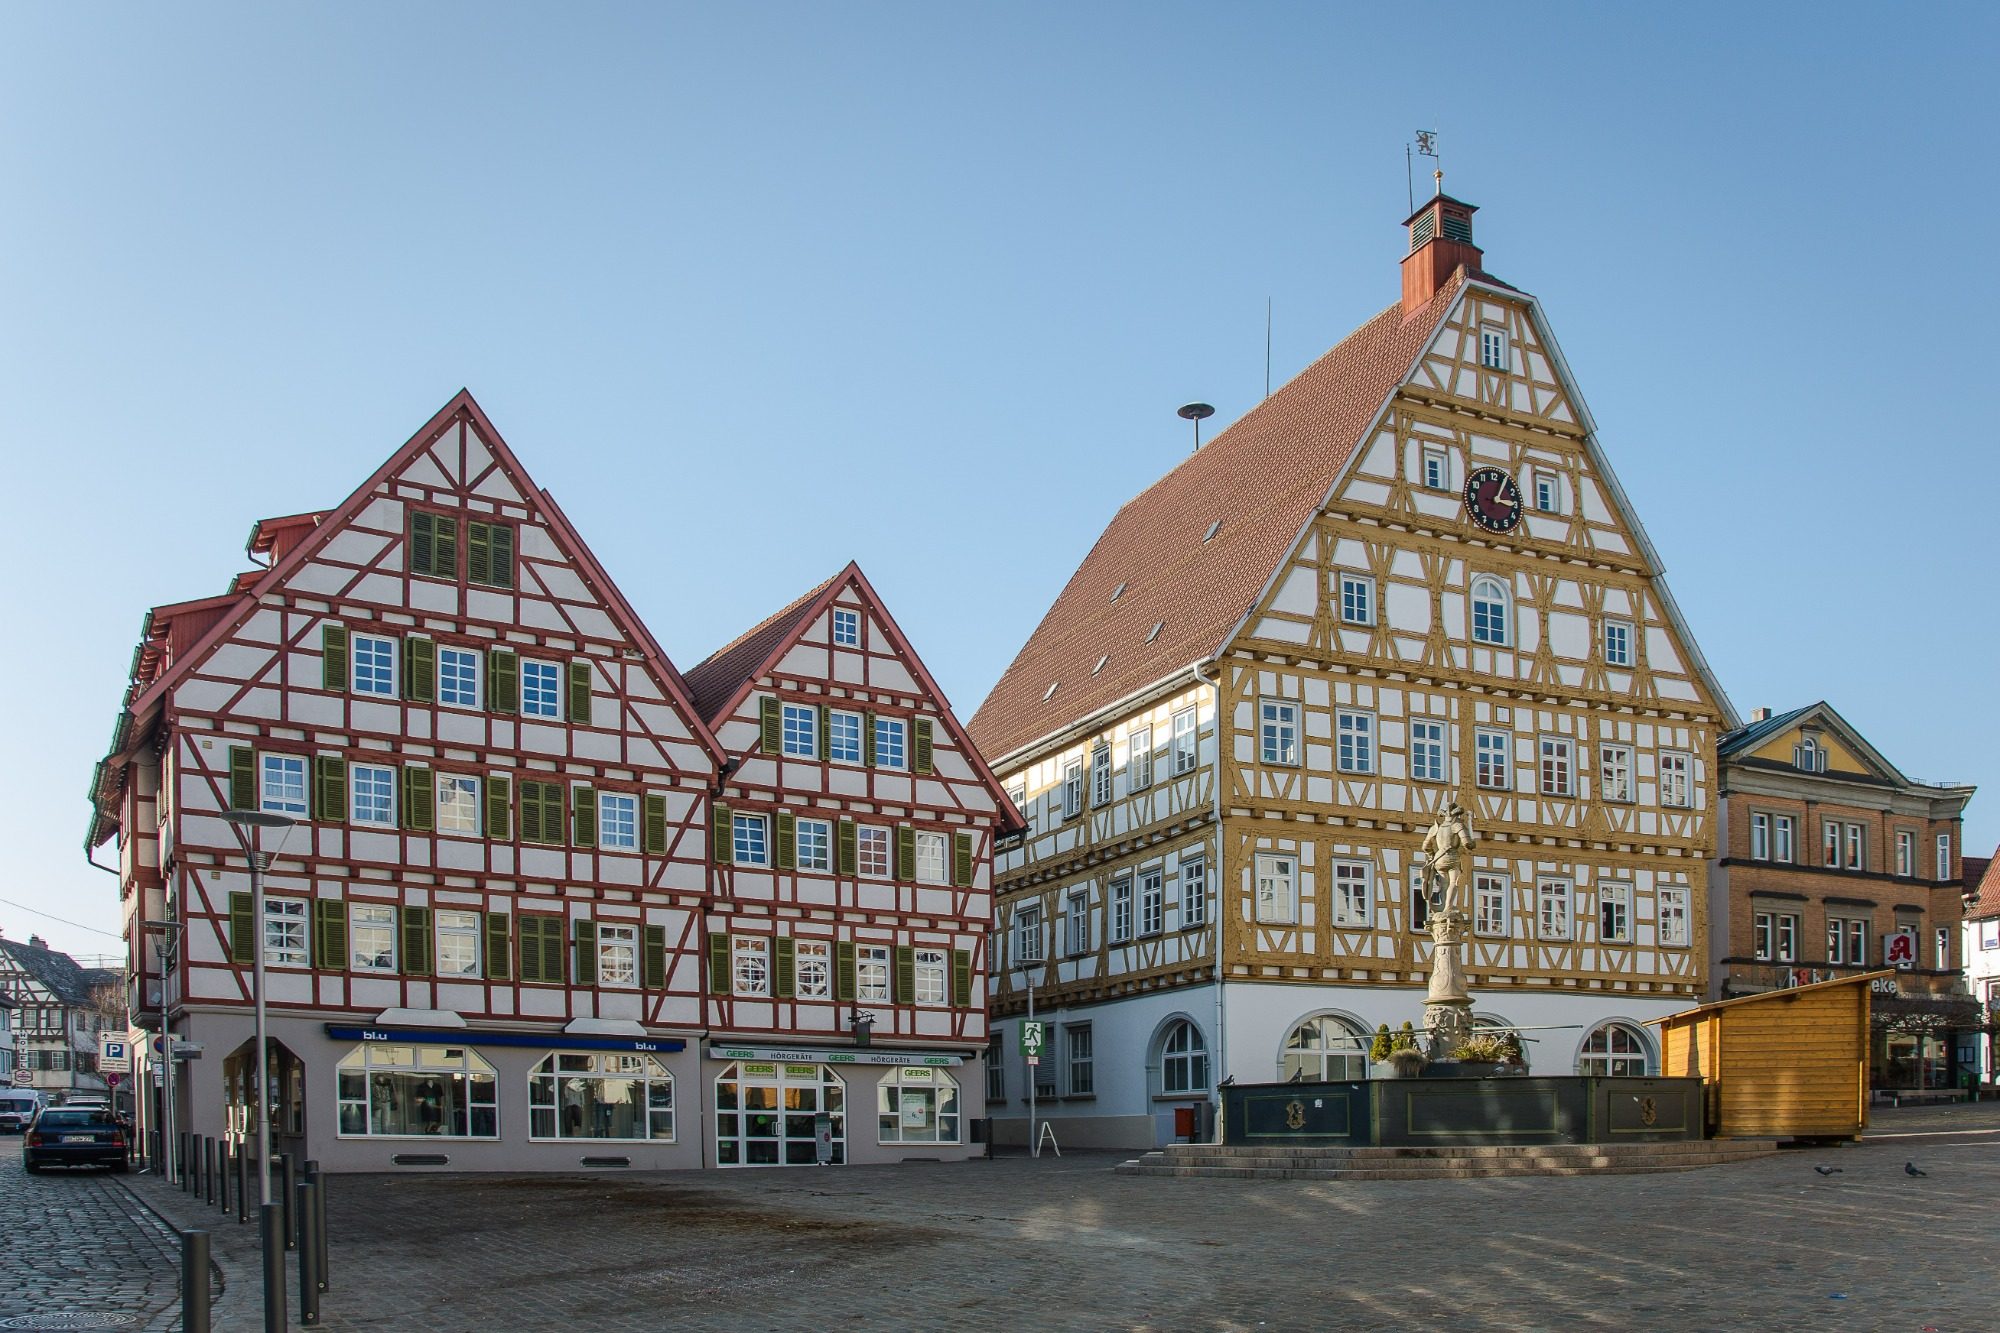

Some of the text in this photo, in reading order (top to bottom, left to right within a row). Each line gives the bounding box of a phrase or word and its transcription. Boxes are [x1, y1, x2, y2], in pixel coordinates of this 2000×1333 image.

[1480, 474, 1486, 482] 11
[1490, 472, 1498, 481] 12
[1472, 481, 1480, 489] 10
[1510, 488, 1516, 496] 2
[1470, 492, 1476, 501] 9
[1474, 504, 1479, 512] 8
[1482, 516, 1487, 524] 7
[1493, 520, 1498, 528] 6
[1504, 518, 1509, 527] 5
[110, 1044, 120, 1056] P
[726, 1050, 754, 1058] GEERS
[744, 1064, 774, 1073] GEERS
[786, 1066, 814, 1074] GEERS
